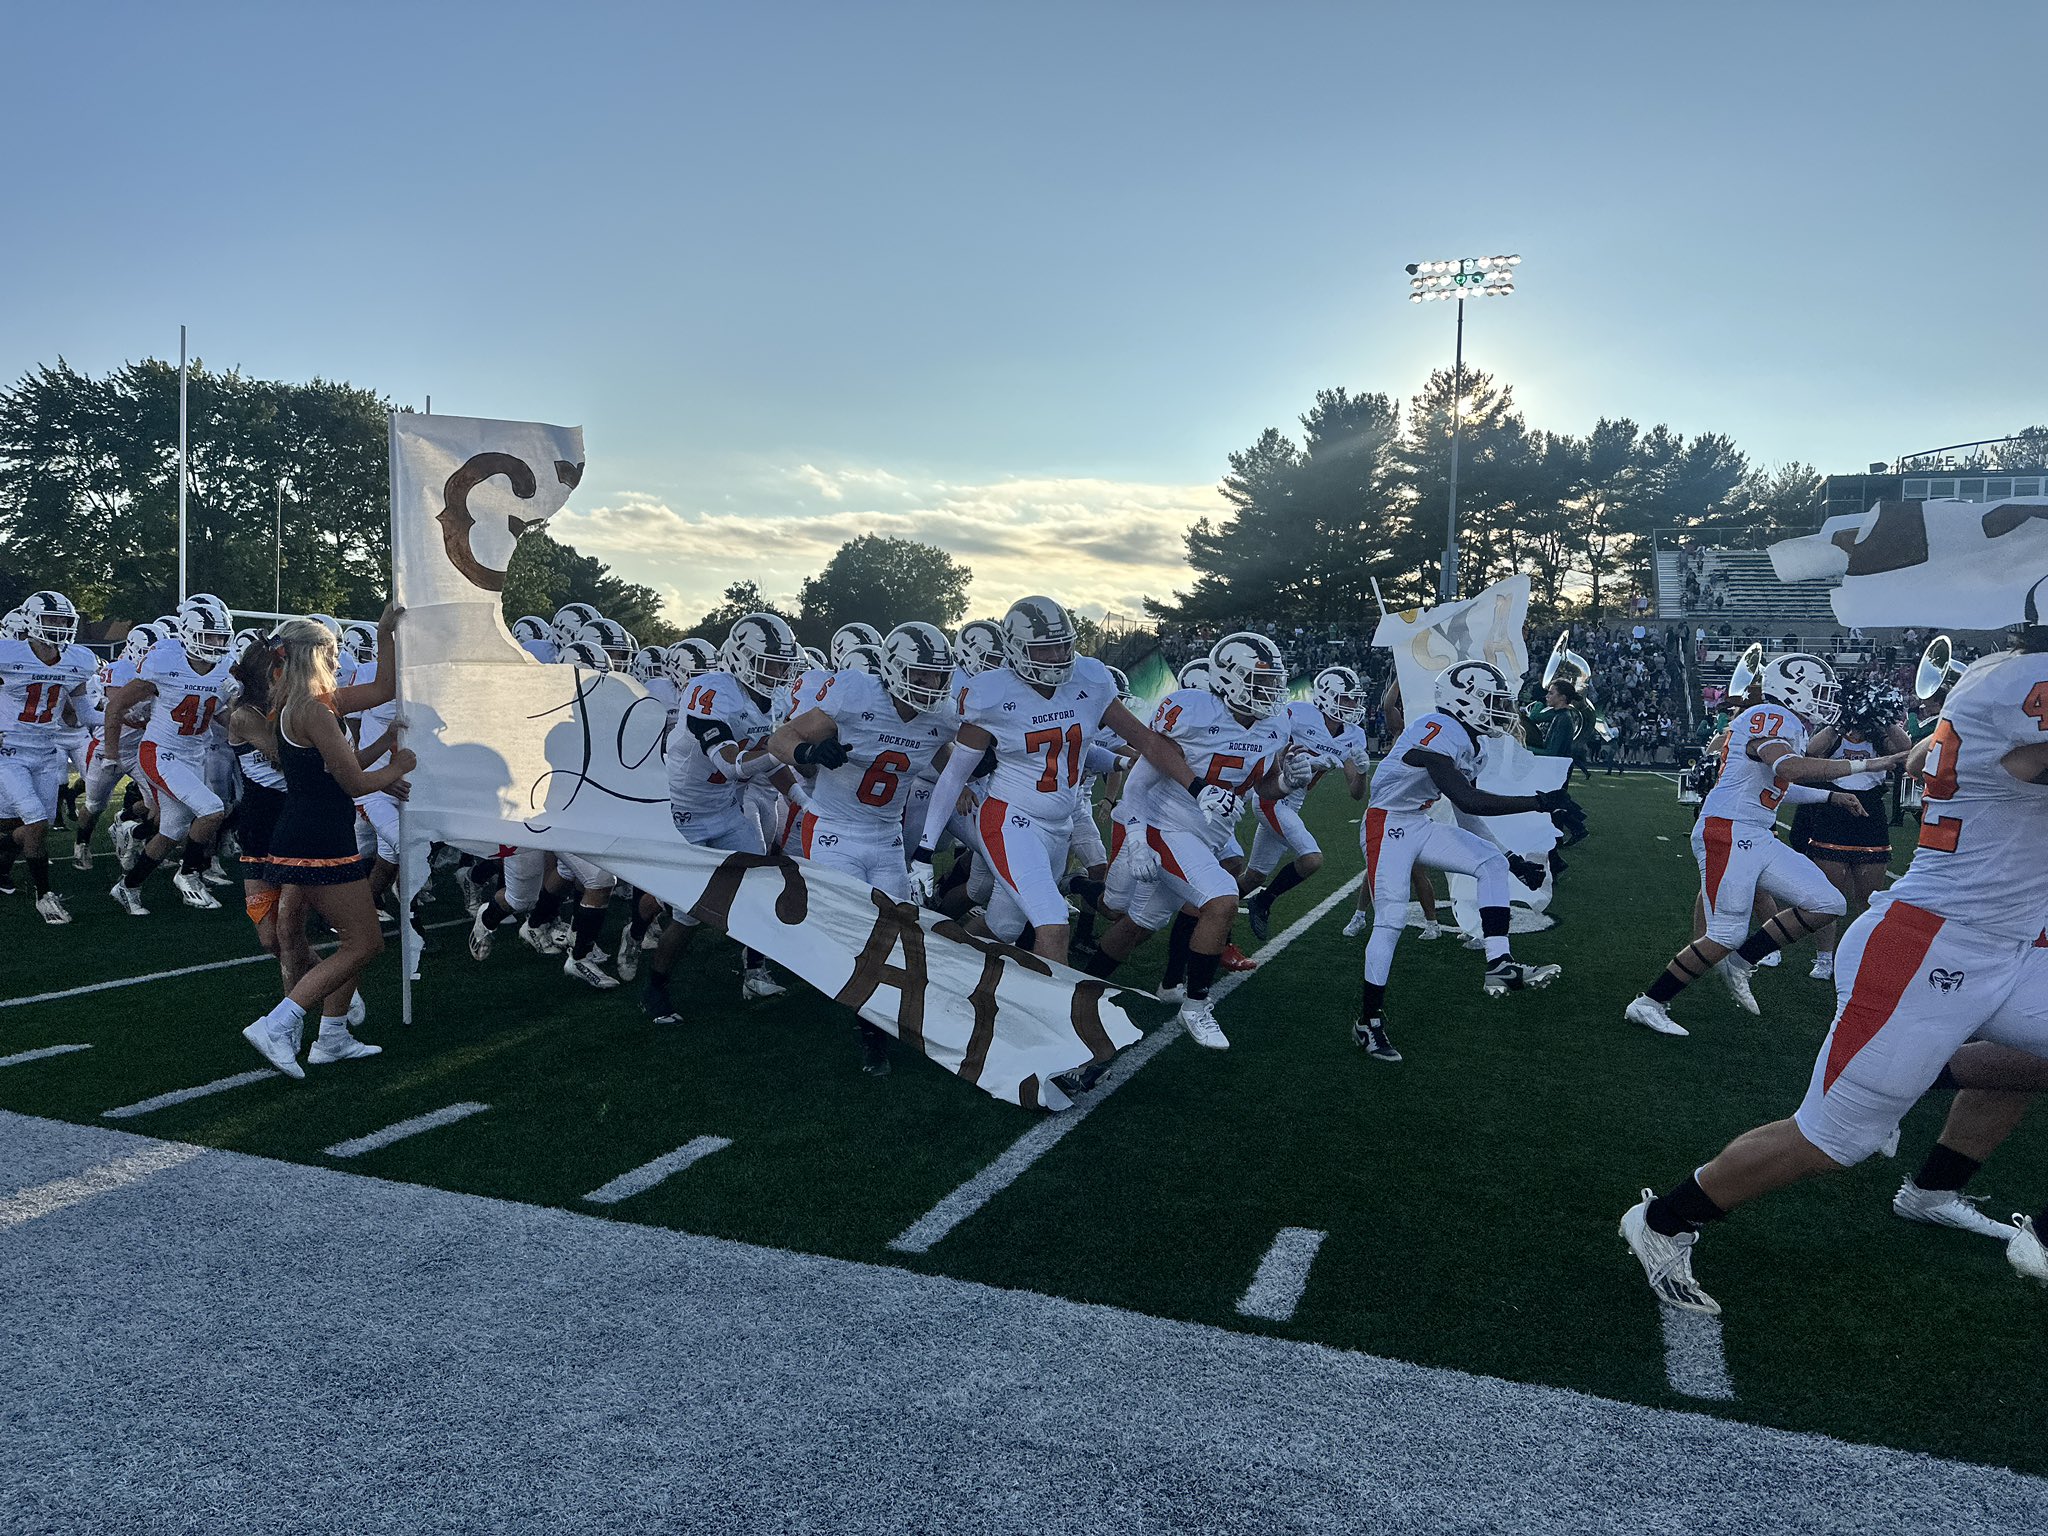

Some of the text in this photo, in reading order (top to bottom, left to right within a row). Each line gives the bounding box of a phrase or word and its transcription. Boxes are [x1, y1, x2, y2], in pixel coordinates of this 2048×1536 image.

[183, 684, 218, 693] ROCKFORD
[687, 685, 717, 716] 14
[18, 682, 63, 724] 11
[170, 694, 219, 736] 41
[1031, 709, 1076, 725] ROCKFORD
[1749, 711, 1785, 737] 97
[877, 732, 921, 750] ROCKFORD
[1228, 741, 1263, 753] ROCKFORD
[1419, 721, 1443, 747] 7
[1024, 722, 1083, 793] 71
[1315, 743, 1343, 757] ROCKFORD
[855, 749, 911, 807] 6
